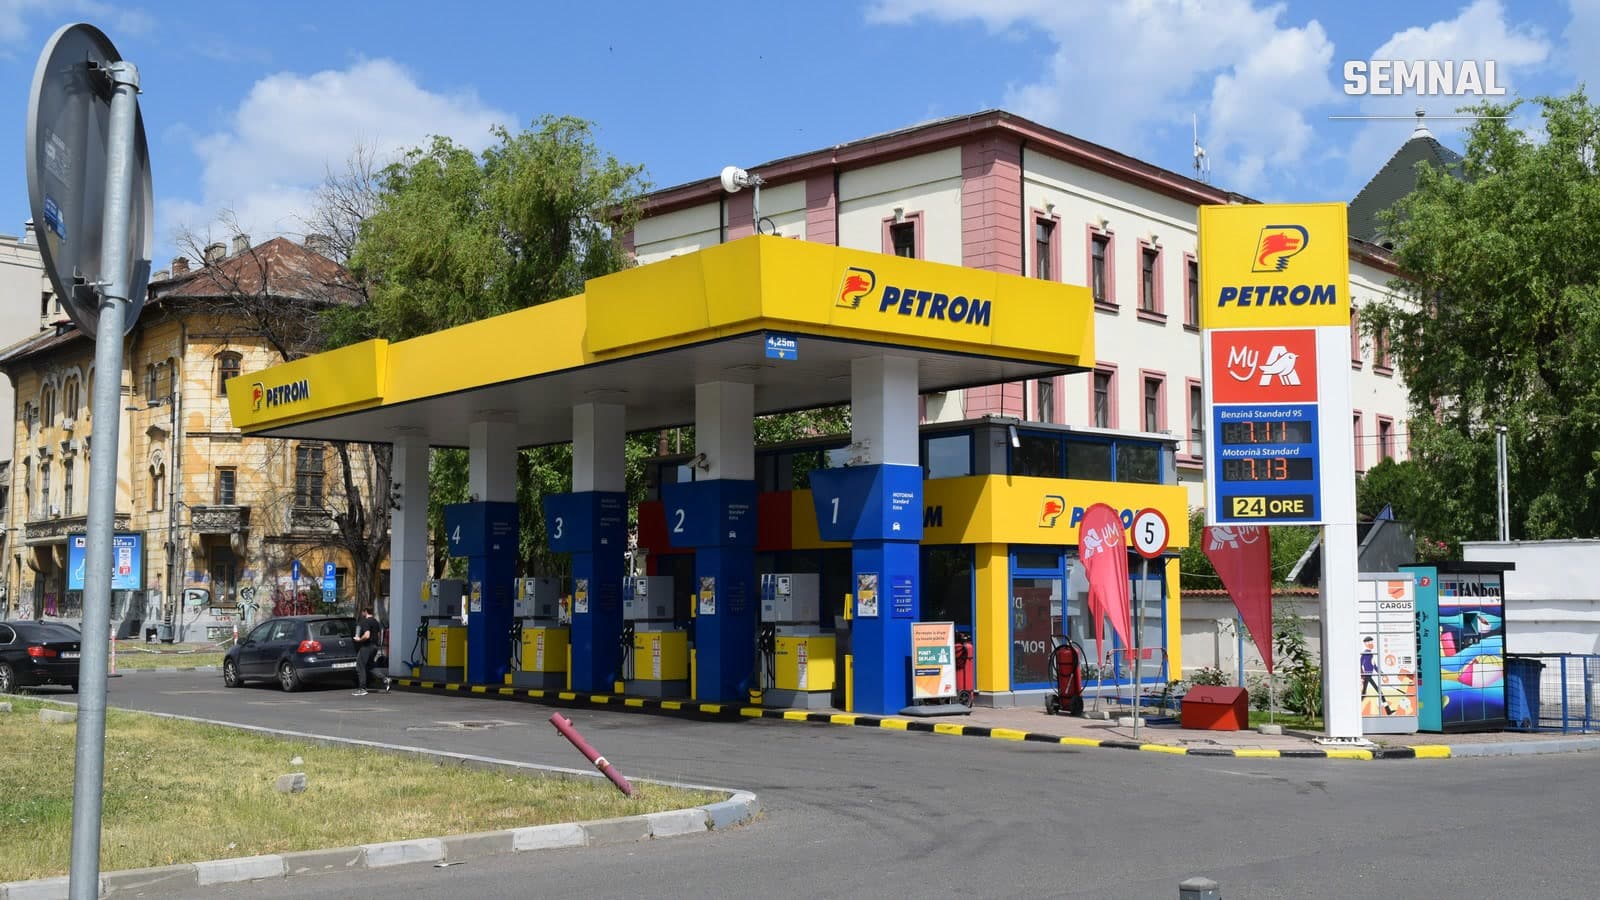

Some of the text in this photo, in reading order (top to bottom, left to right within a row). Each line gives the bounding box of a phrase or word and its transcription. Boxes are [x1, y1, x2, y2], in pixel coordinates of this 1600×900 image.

[879, 286, 991, 327] PETROM
[1218, 285, 1336, 307] PETROM
[768, 336, 795, 348] 4,25m
[1227, 346, 1259, 381] My
[266, 379, 309, 408] PETROM
[1221, 410, 1253, 418] Benzină
[1254, 409, 1291, 418] Standard
[1242, 421, 1286, 443] 7.11
[1222, 447, 1299, 457] Motorină Standard
[1243, 457, 1287, 480] 7.13
[832, 497, 839, 524] 1
[1236, 499, 1304, 515] 24 ORE
[553, 517, 563, 539] 3
[673, 508, 686, 533] 2
[452, 524, 460, 544] 4
[1144, 521, 1155, 545] 5
[326, 564, 333, 576] P
